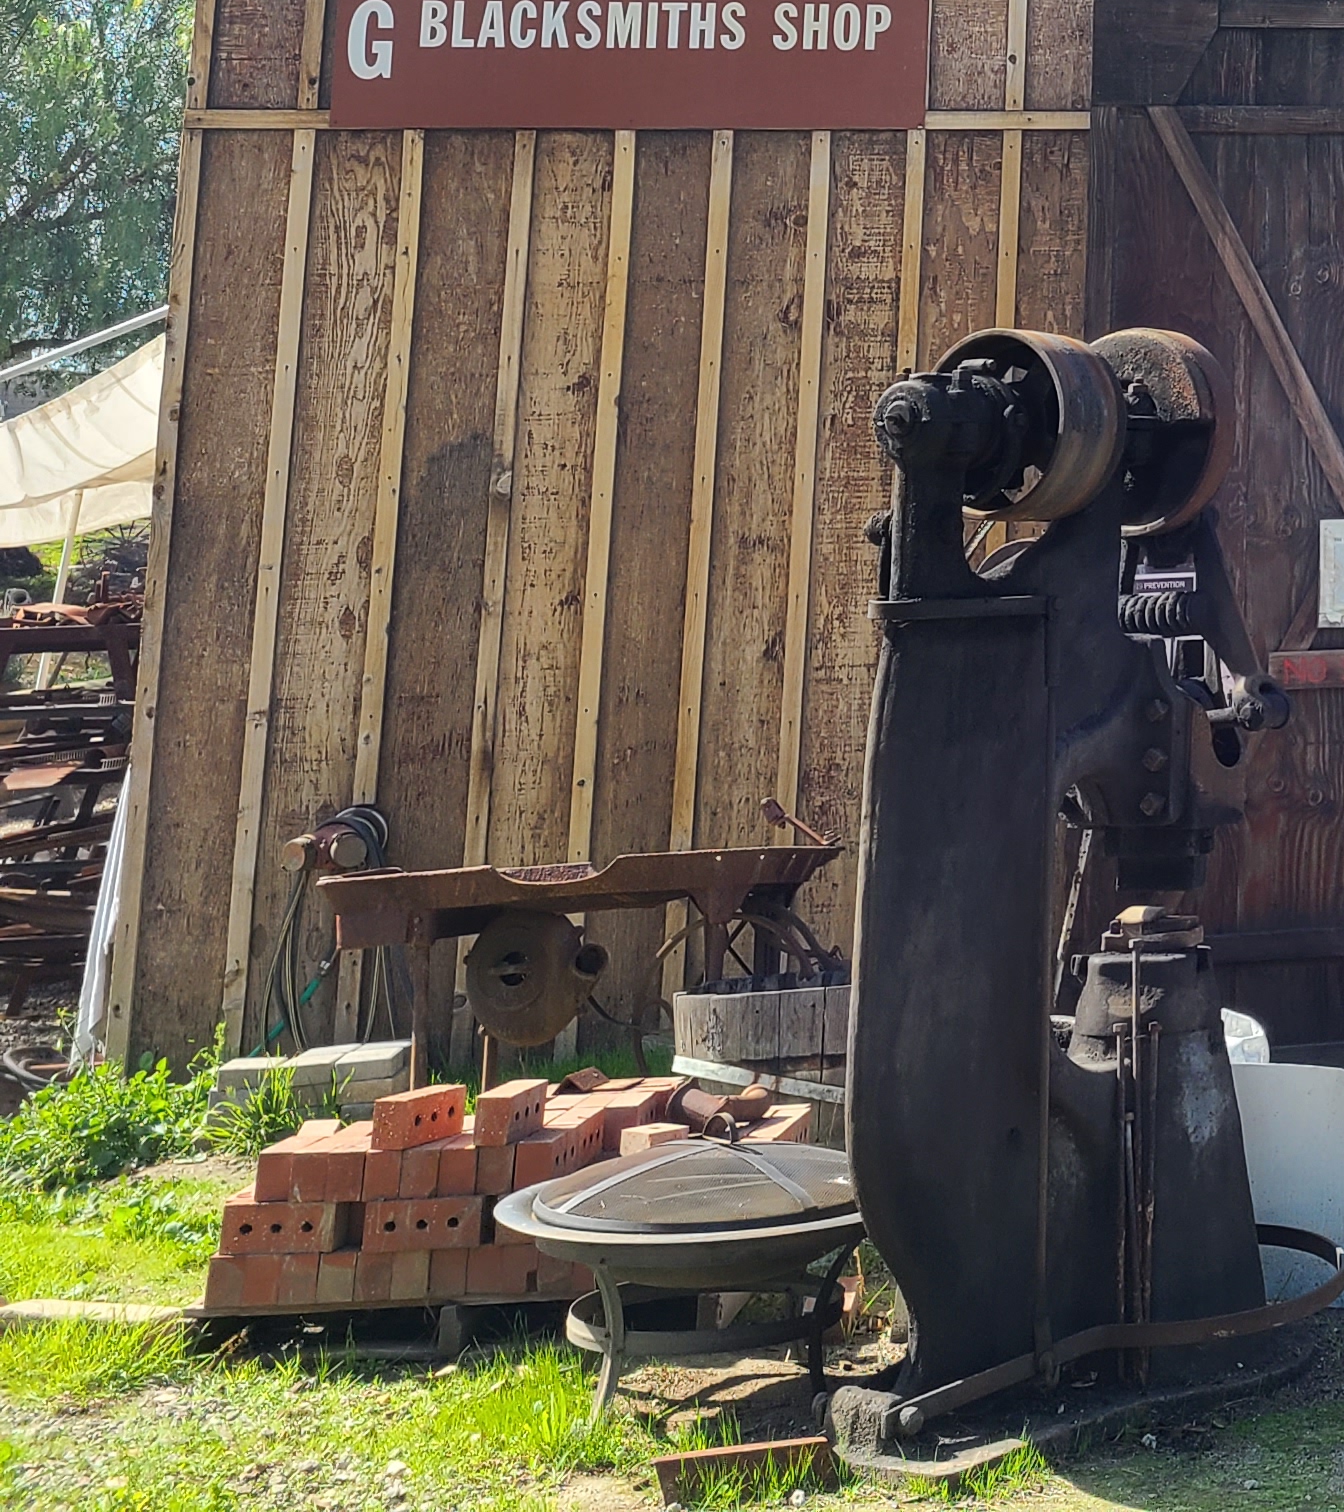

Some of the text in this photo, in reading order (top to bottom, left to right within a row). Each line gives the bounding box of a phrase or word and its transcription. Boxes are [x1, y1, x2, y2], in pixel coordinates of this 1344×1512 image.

[419, 0, 747, 51] BLACKSMITHS
[773, 2, 893, 52] SHOP
[1143, 580, 1186, 590] PREVENTION
[1284, 656, 1328, 685] NO
